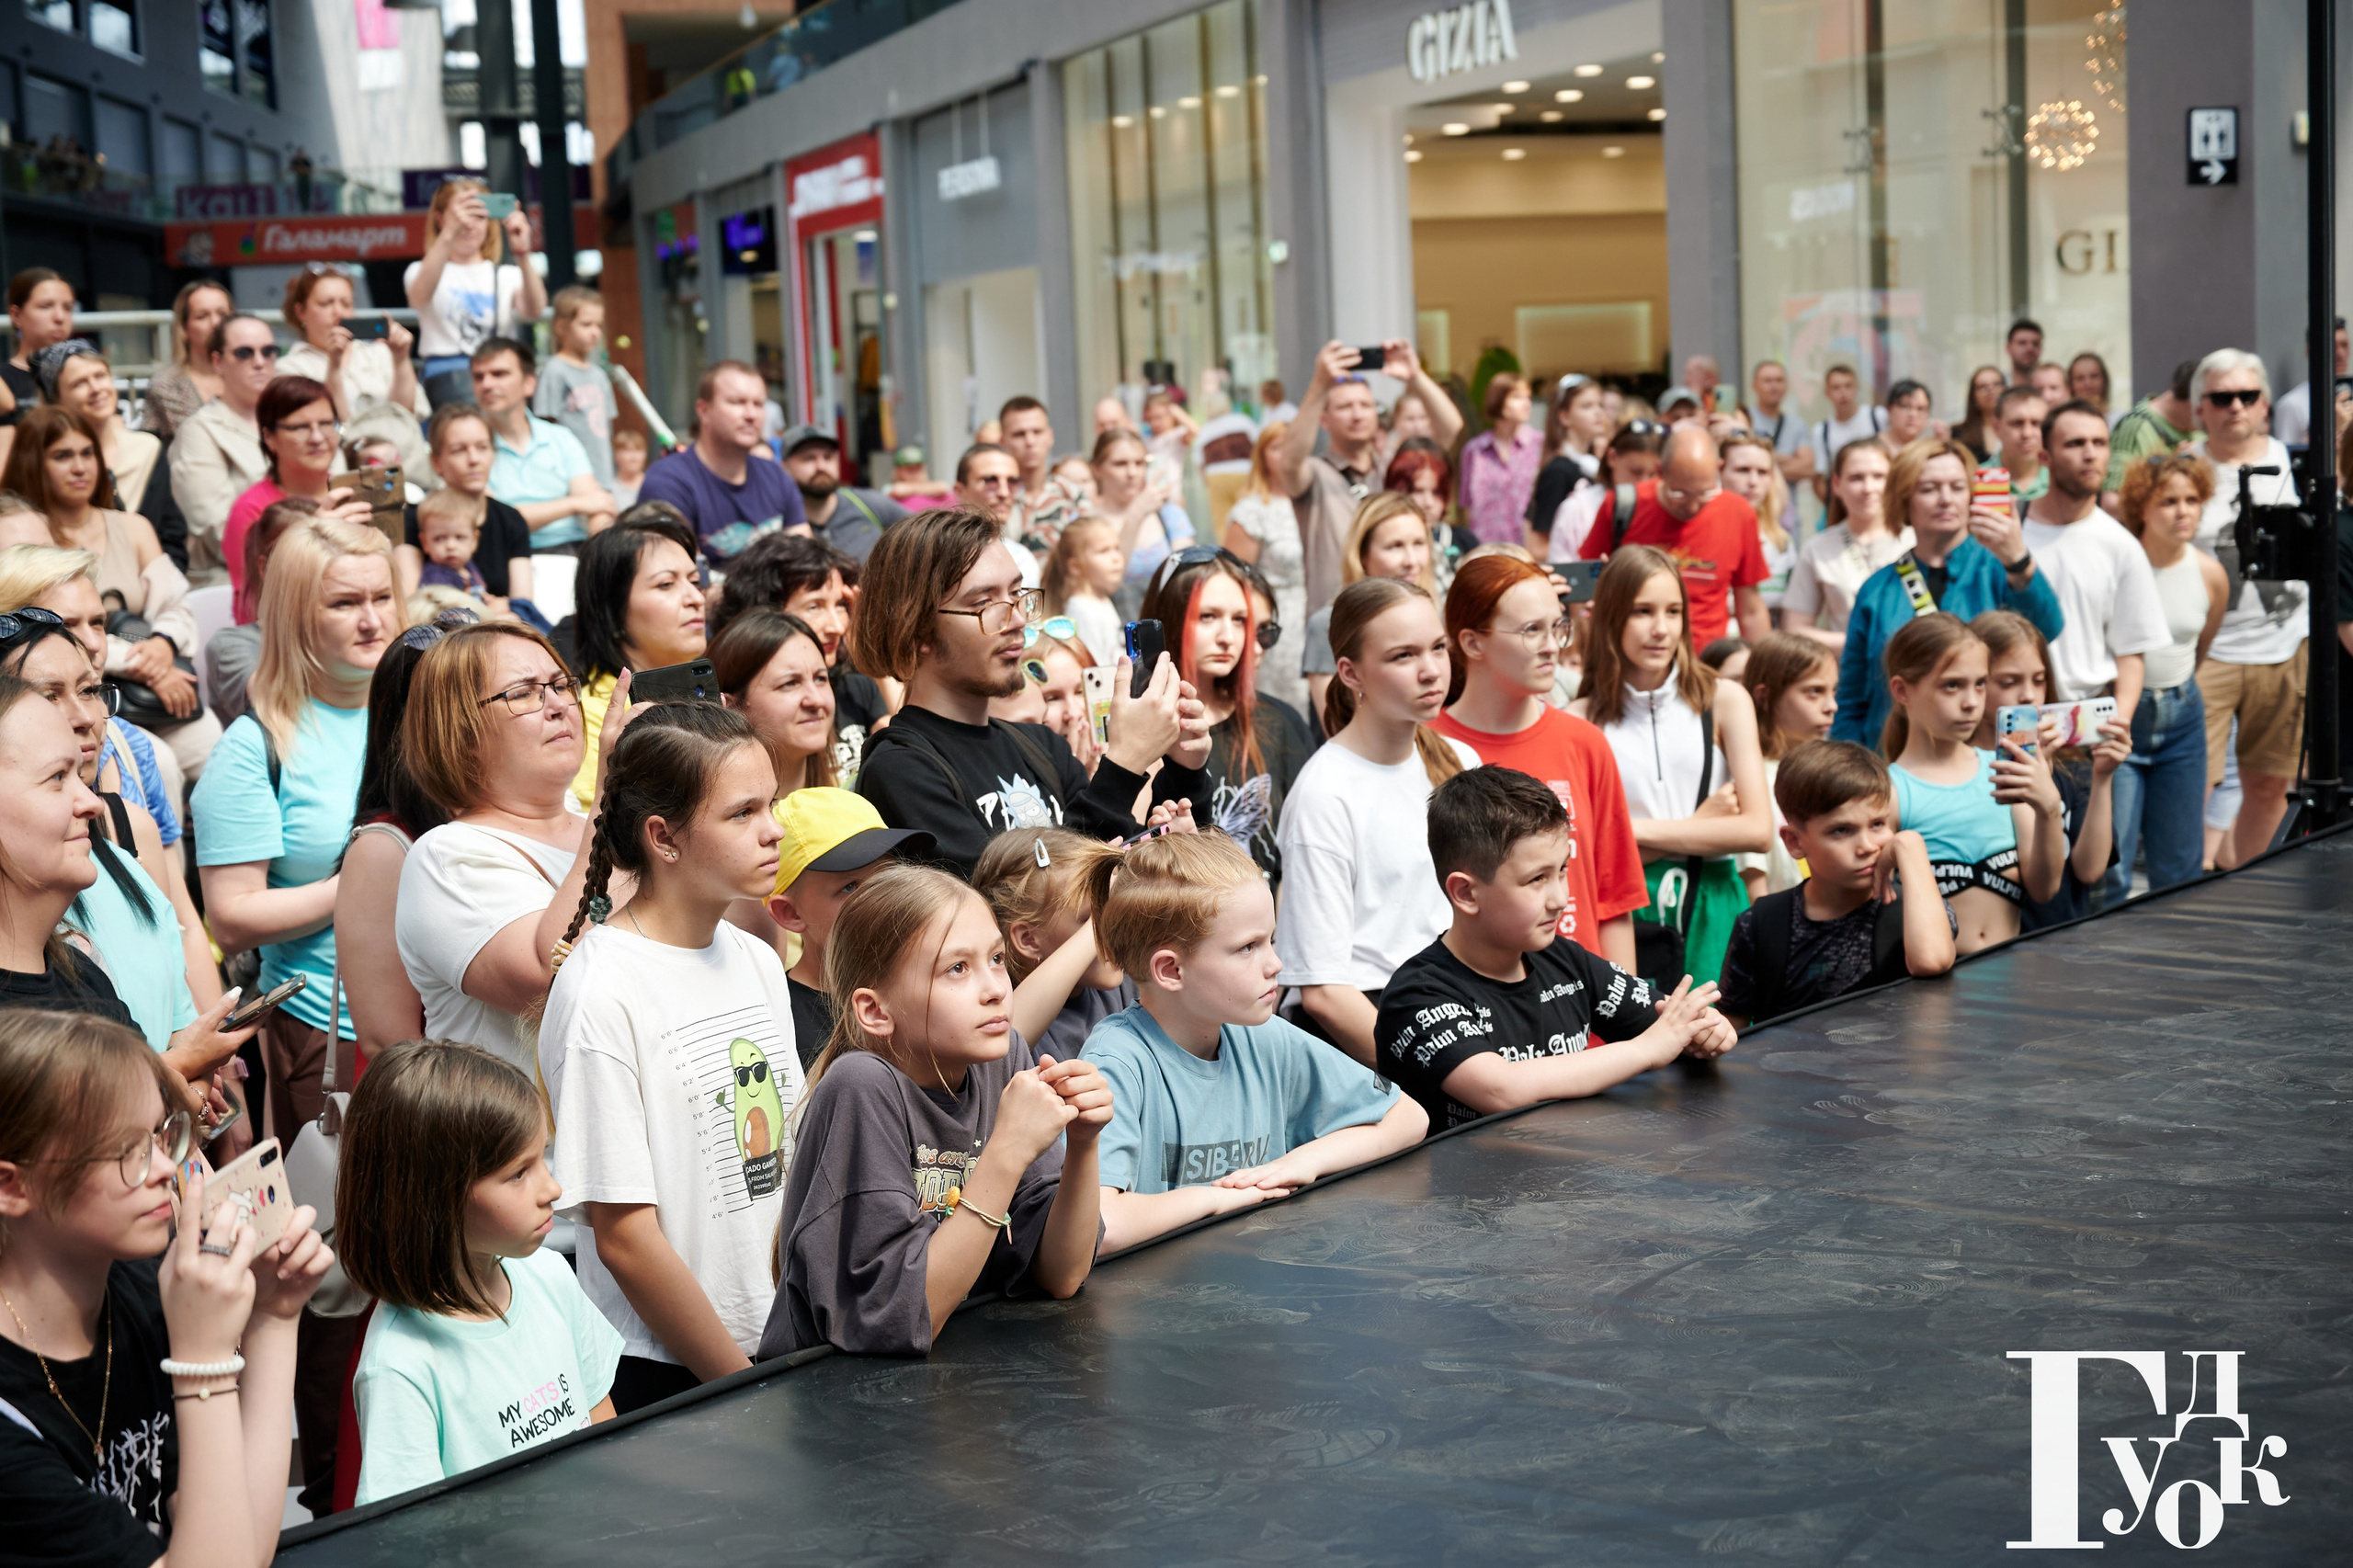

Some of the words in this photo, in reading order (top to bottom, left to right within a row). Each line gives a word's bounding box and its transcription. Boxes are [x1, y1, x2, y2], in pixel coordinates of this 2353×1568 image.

[1406, 0, 1518, 84] GIZIA
[264, 223, 407, 257] Галамарт
[2055, 229, 2129, 276] GI
[1414, 1029, 1458, 1068] Palm
[498, 1401, 522, 1428] MY
[523, 1381, 560, 1414] CATS
[558, 1373, 569, 1394] IS
